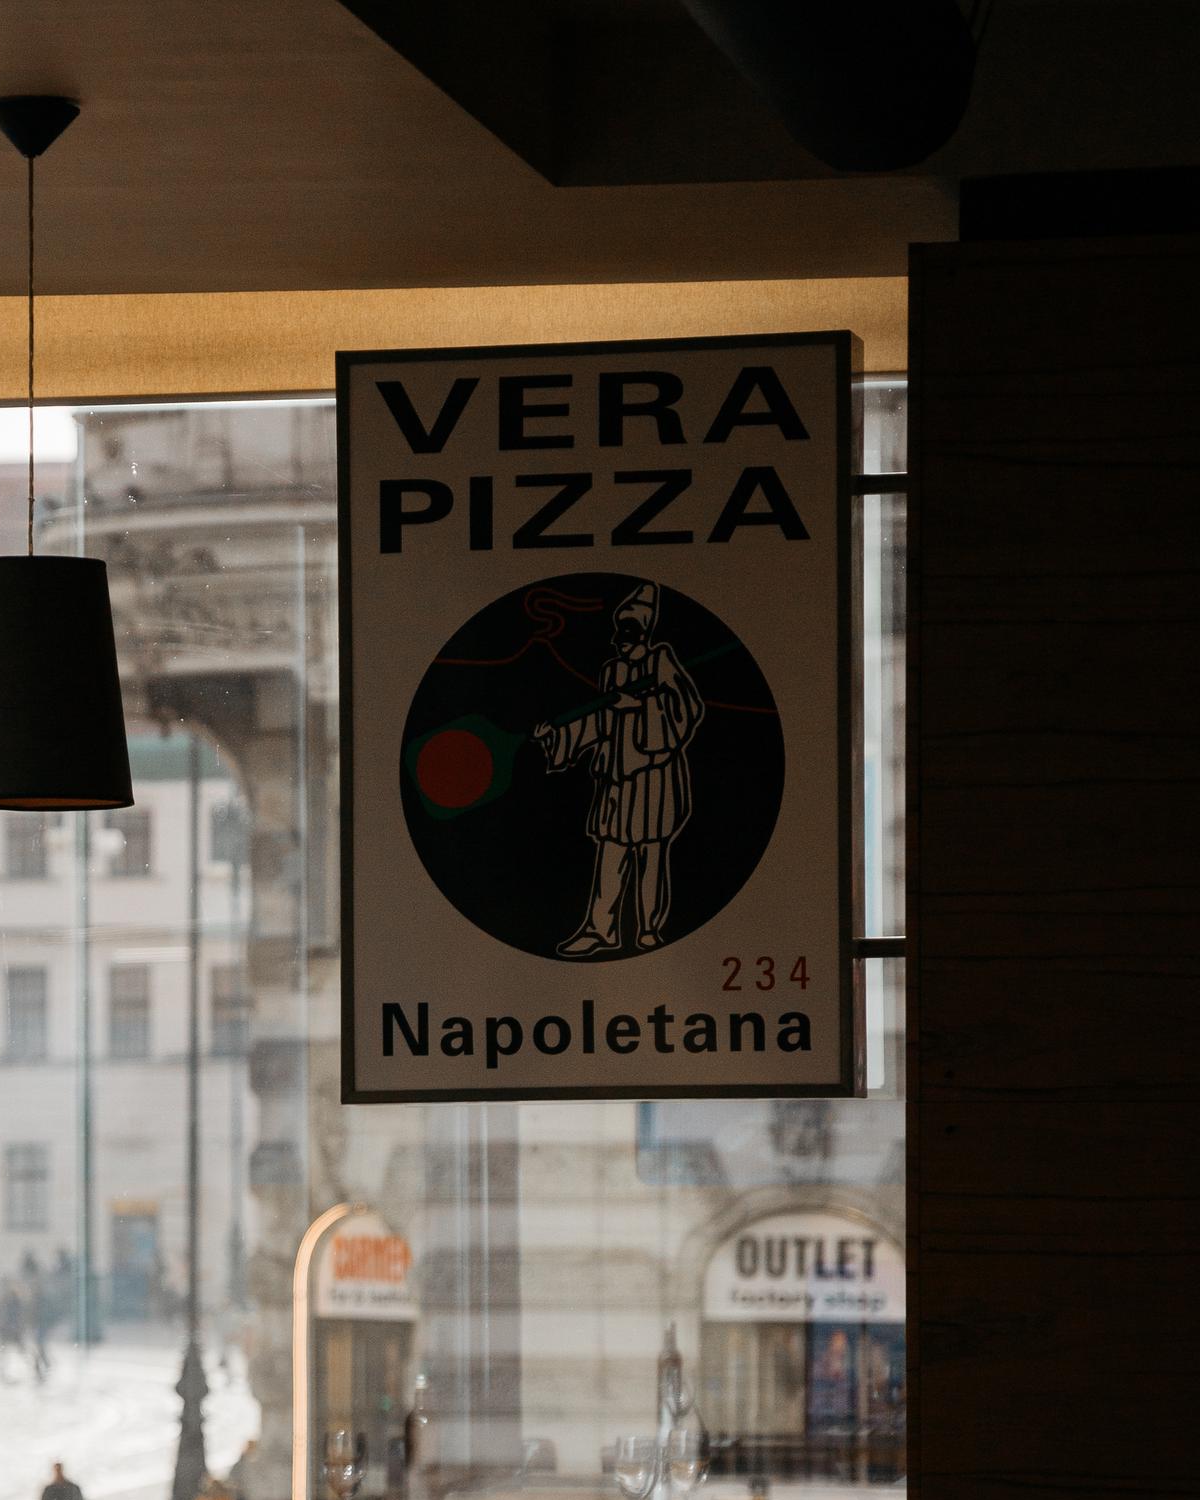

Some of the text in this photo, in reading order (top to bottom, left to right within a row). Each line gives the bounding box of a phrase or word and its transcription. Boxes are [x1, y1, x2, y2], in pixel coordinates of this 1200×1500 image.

[375, 366, 811, 454] VERA
[379, 465, 811, 554] PIZZA
[382, 1000, 812, 1069] Napoletana
[735, 1234, 876, 1280] OUTLET
